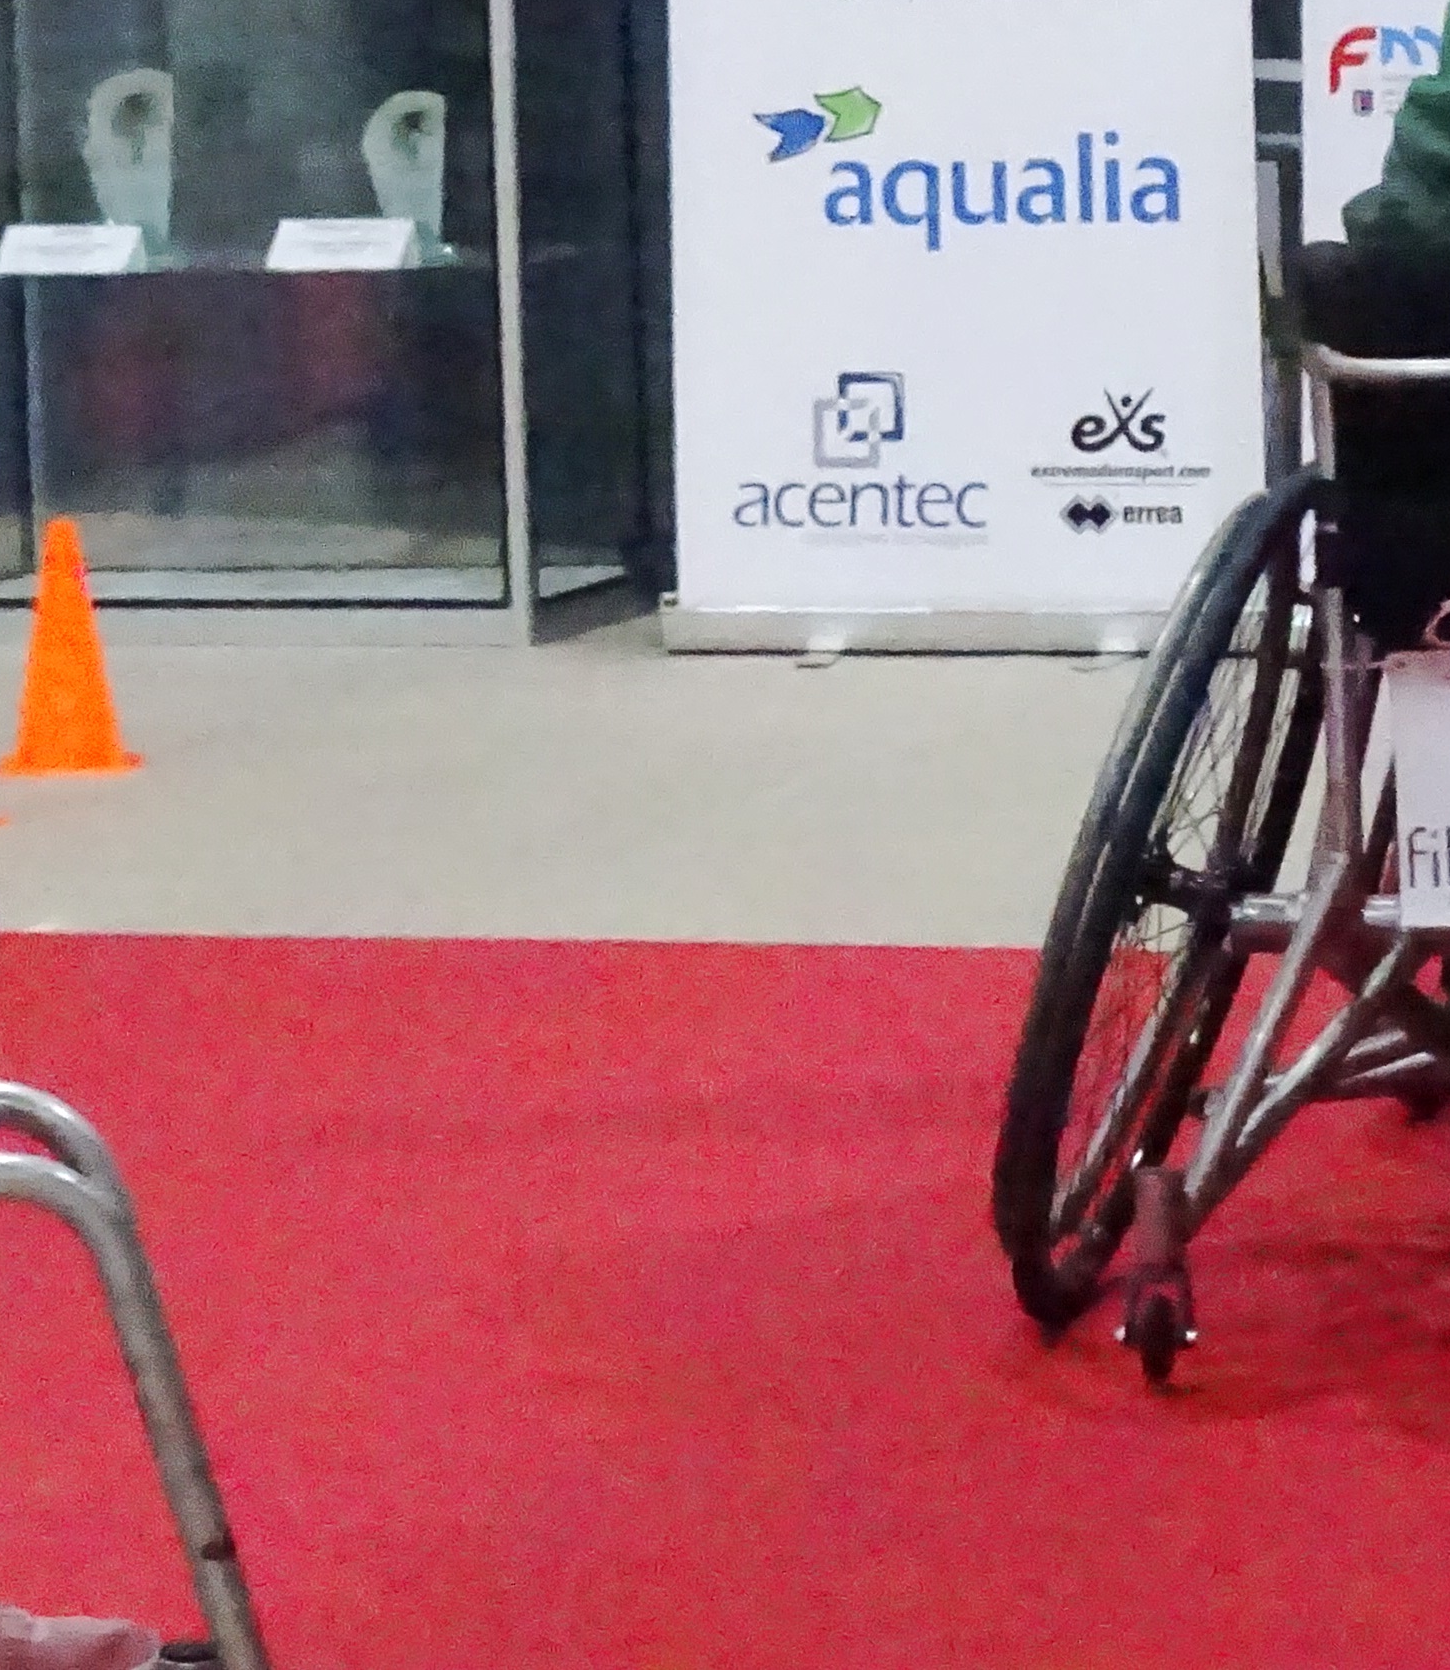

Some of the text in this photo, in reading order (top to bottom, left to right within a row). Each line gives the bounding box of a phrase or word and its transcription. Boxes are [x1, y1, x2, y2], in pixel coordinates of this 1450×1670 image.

[824, 132, 1181, 252] aqualia
[733, 474, 989, 528] acentec
[1123, 505, 1182, 524] errea
